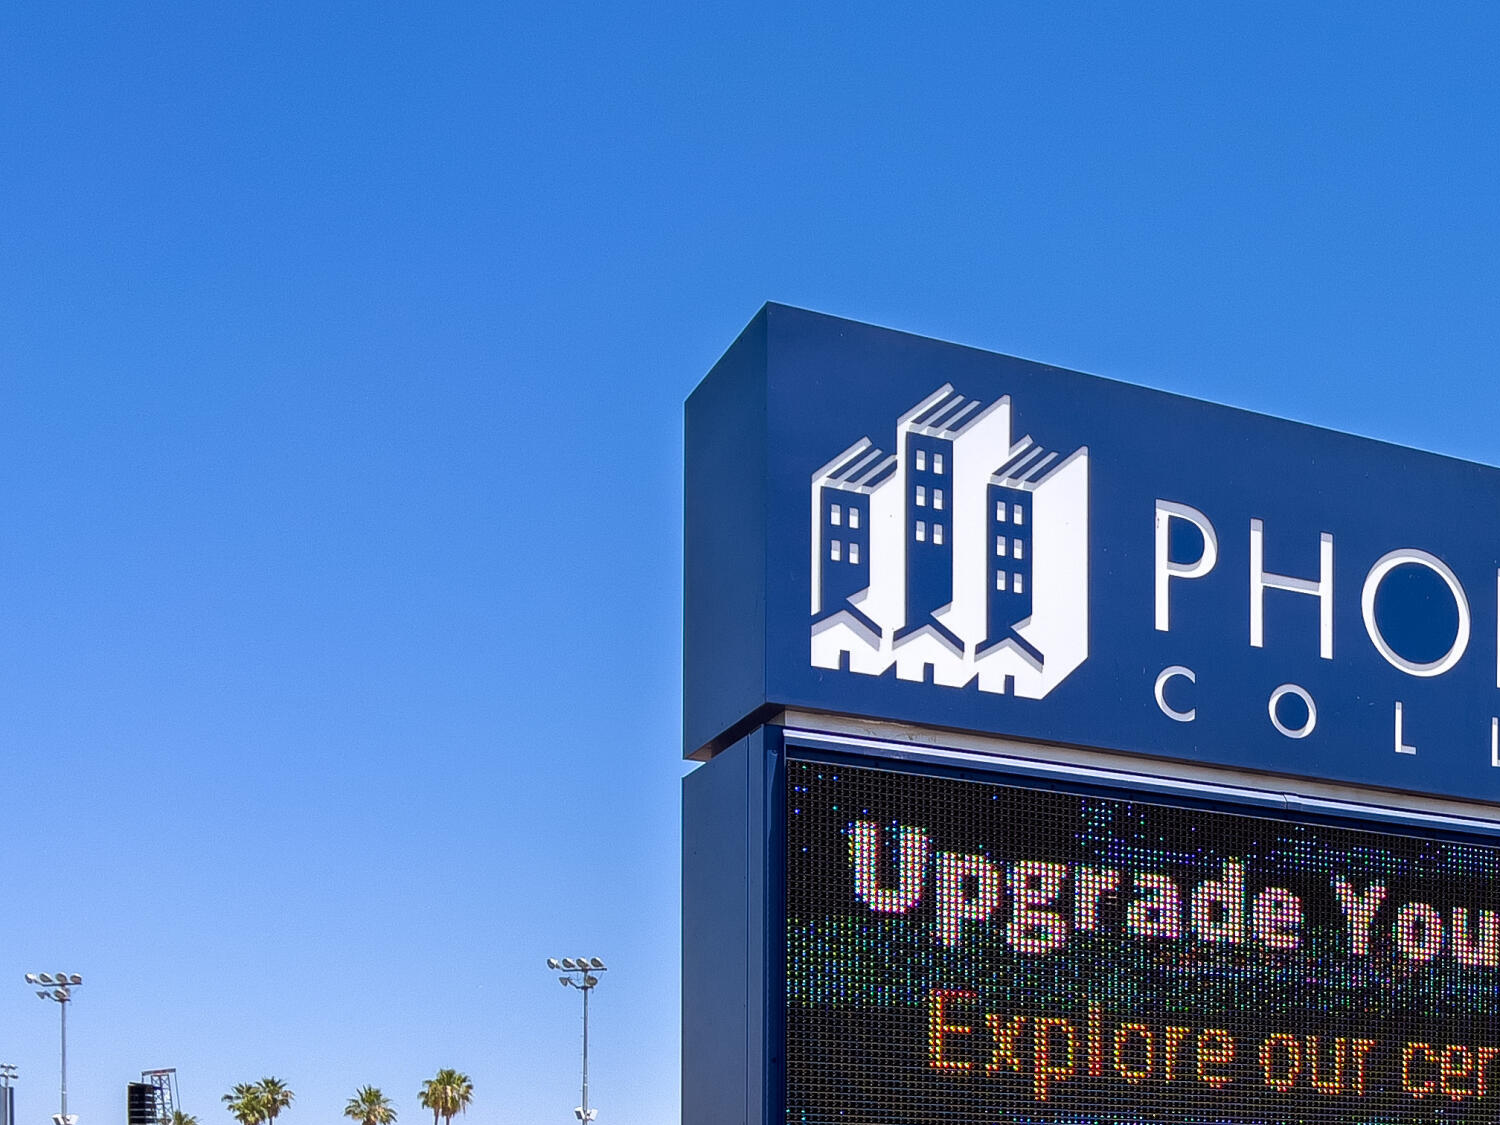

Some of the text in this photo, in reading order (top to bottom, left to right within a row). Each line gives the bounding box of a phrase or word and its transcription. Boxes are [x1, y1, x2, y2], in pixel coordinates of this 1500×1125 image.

[848, 820, 1303, 953] Upgrade
[929, 988, 1235, 1102] Explore
[1259, 1029, 1375, 1098] our
